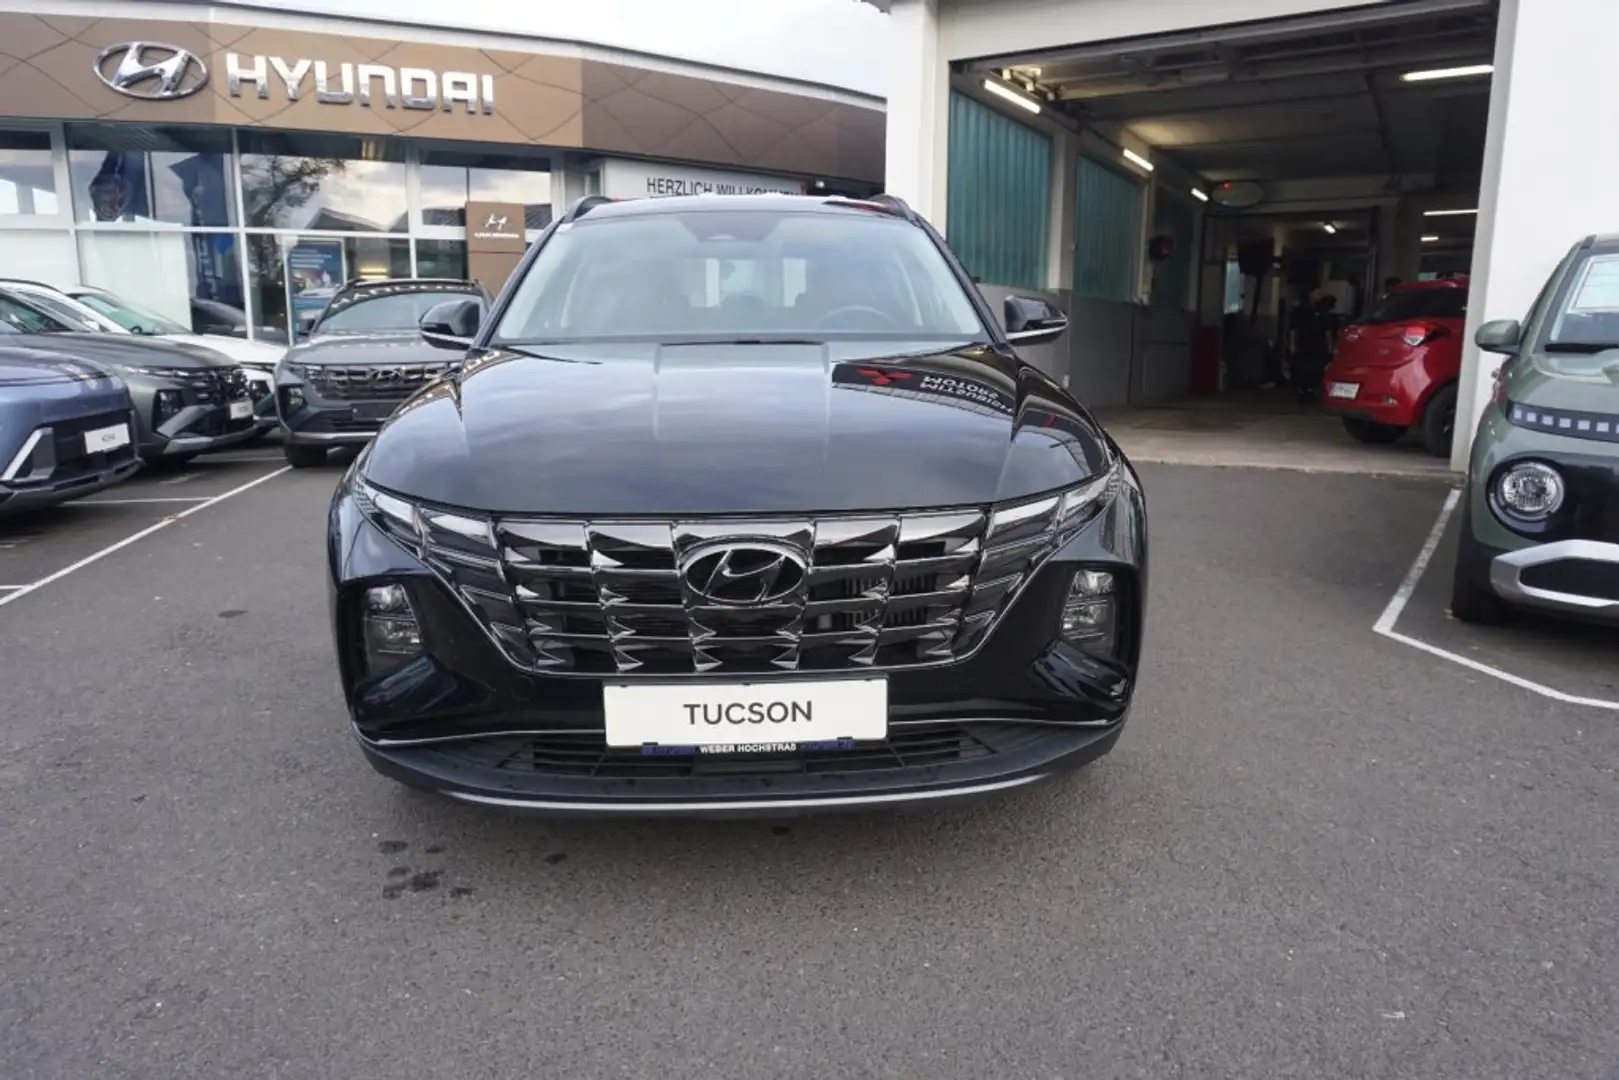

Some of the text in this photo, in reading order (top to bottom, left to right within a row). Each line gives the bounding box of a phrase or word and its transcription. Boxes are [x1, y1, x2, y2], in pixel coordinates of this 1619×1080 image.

[226, 53, 494, 116] HYUNDAI
[646, 177, 799, 196] HERZLICH WILLKO
[683, 700, 813, 725] TUCSON
[700, 743, 735, 754] WEBER
